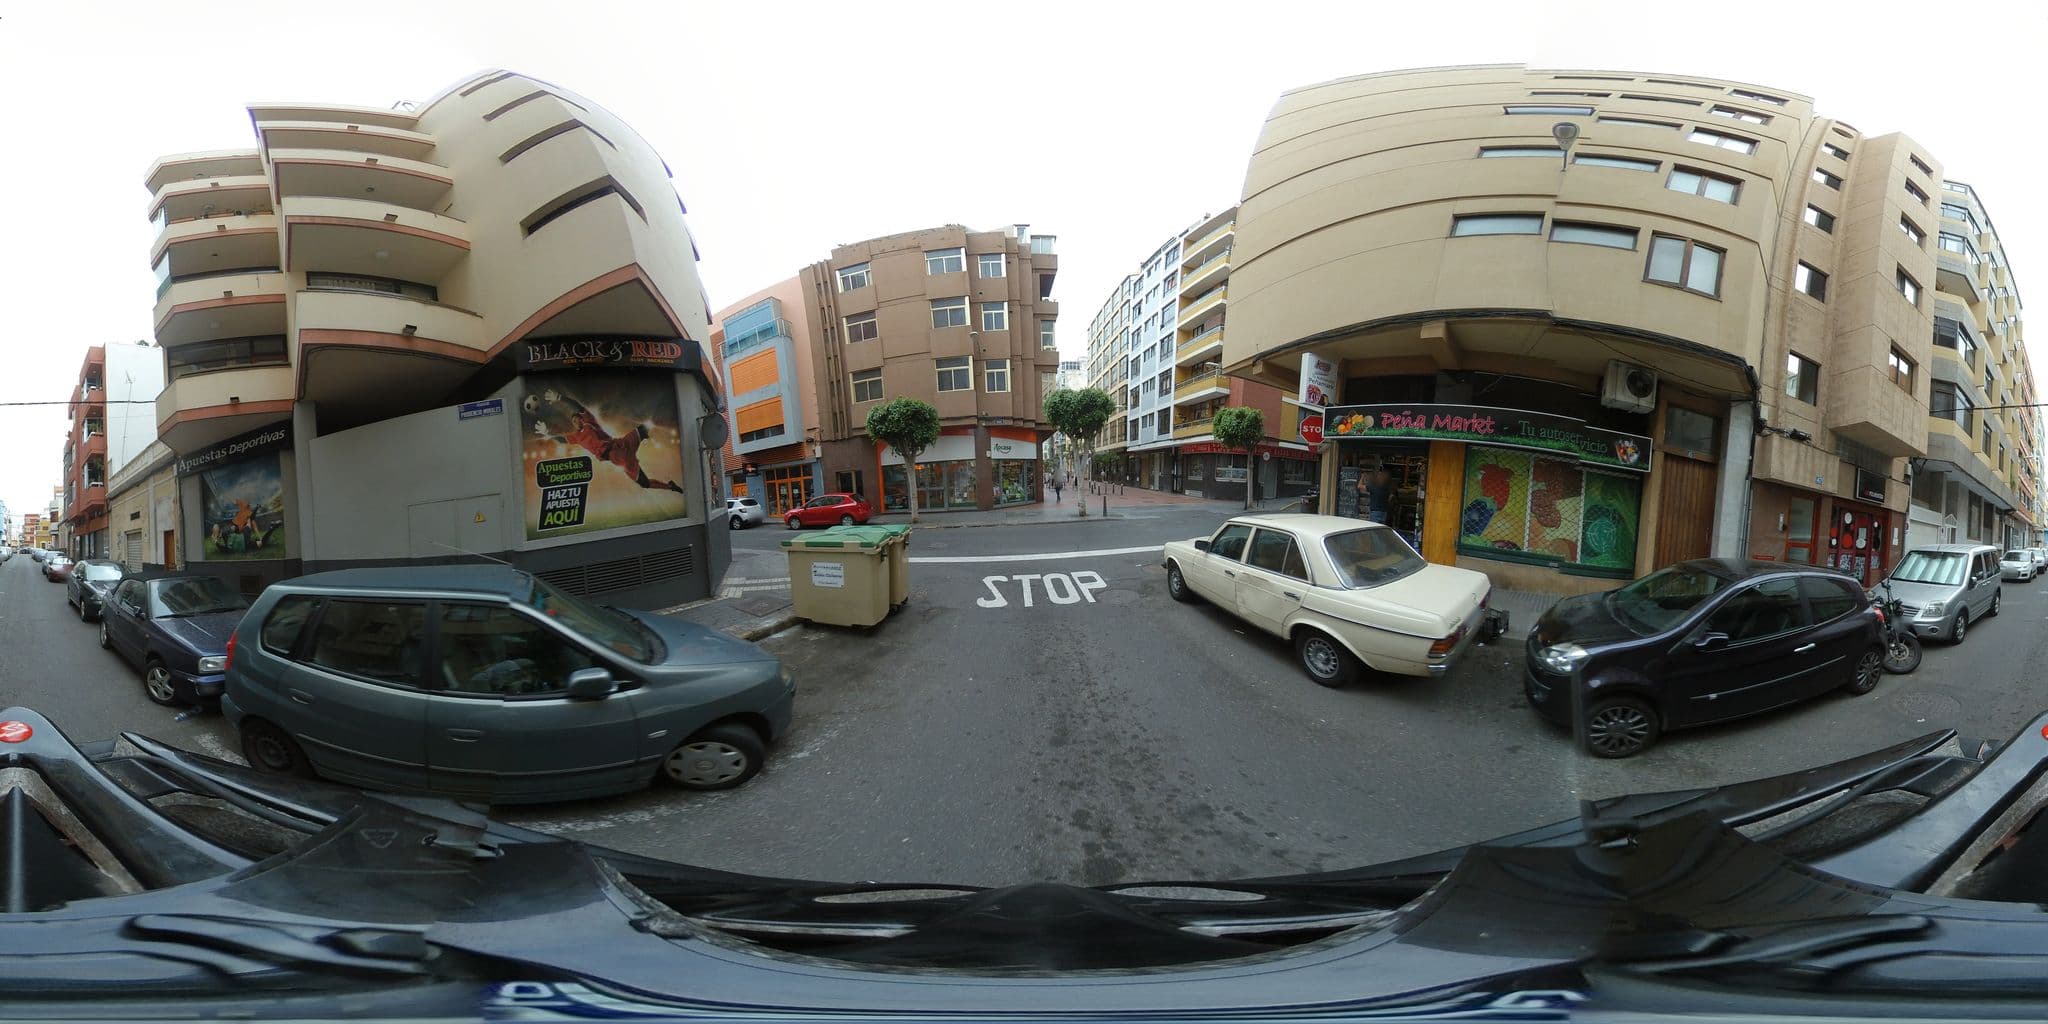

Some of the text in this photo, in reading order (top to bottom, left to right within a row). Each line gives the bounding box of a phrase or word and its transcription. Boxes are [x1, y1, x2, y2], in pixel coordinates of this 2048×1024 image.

[528, 341, 682, 363] BLACK & RED
[1302, 425, 1321, 433] STO
[1381, 410, 1426, 430] Peña
[1519, 420, 1536, 436] Tu
[1540, 427, 1608, 453] autoservicio
[179, 429, 286, 473] Apuestas Deportivas
[538, 460, 584, 475] Apuestas
[550, 470, 592, 484] Deportivas
[547, 487, 581, 500] HAZ TU
[545, 497, 580, 510] APUESTA
[544, 506, 579, 525] AQUÍ
[976, 571, 1107, 608] STOP
